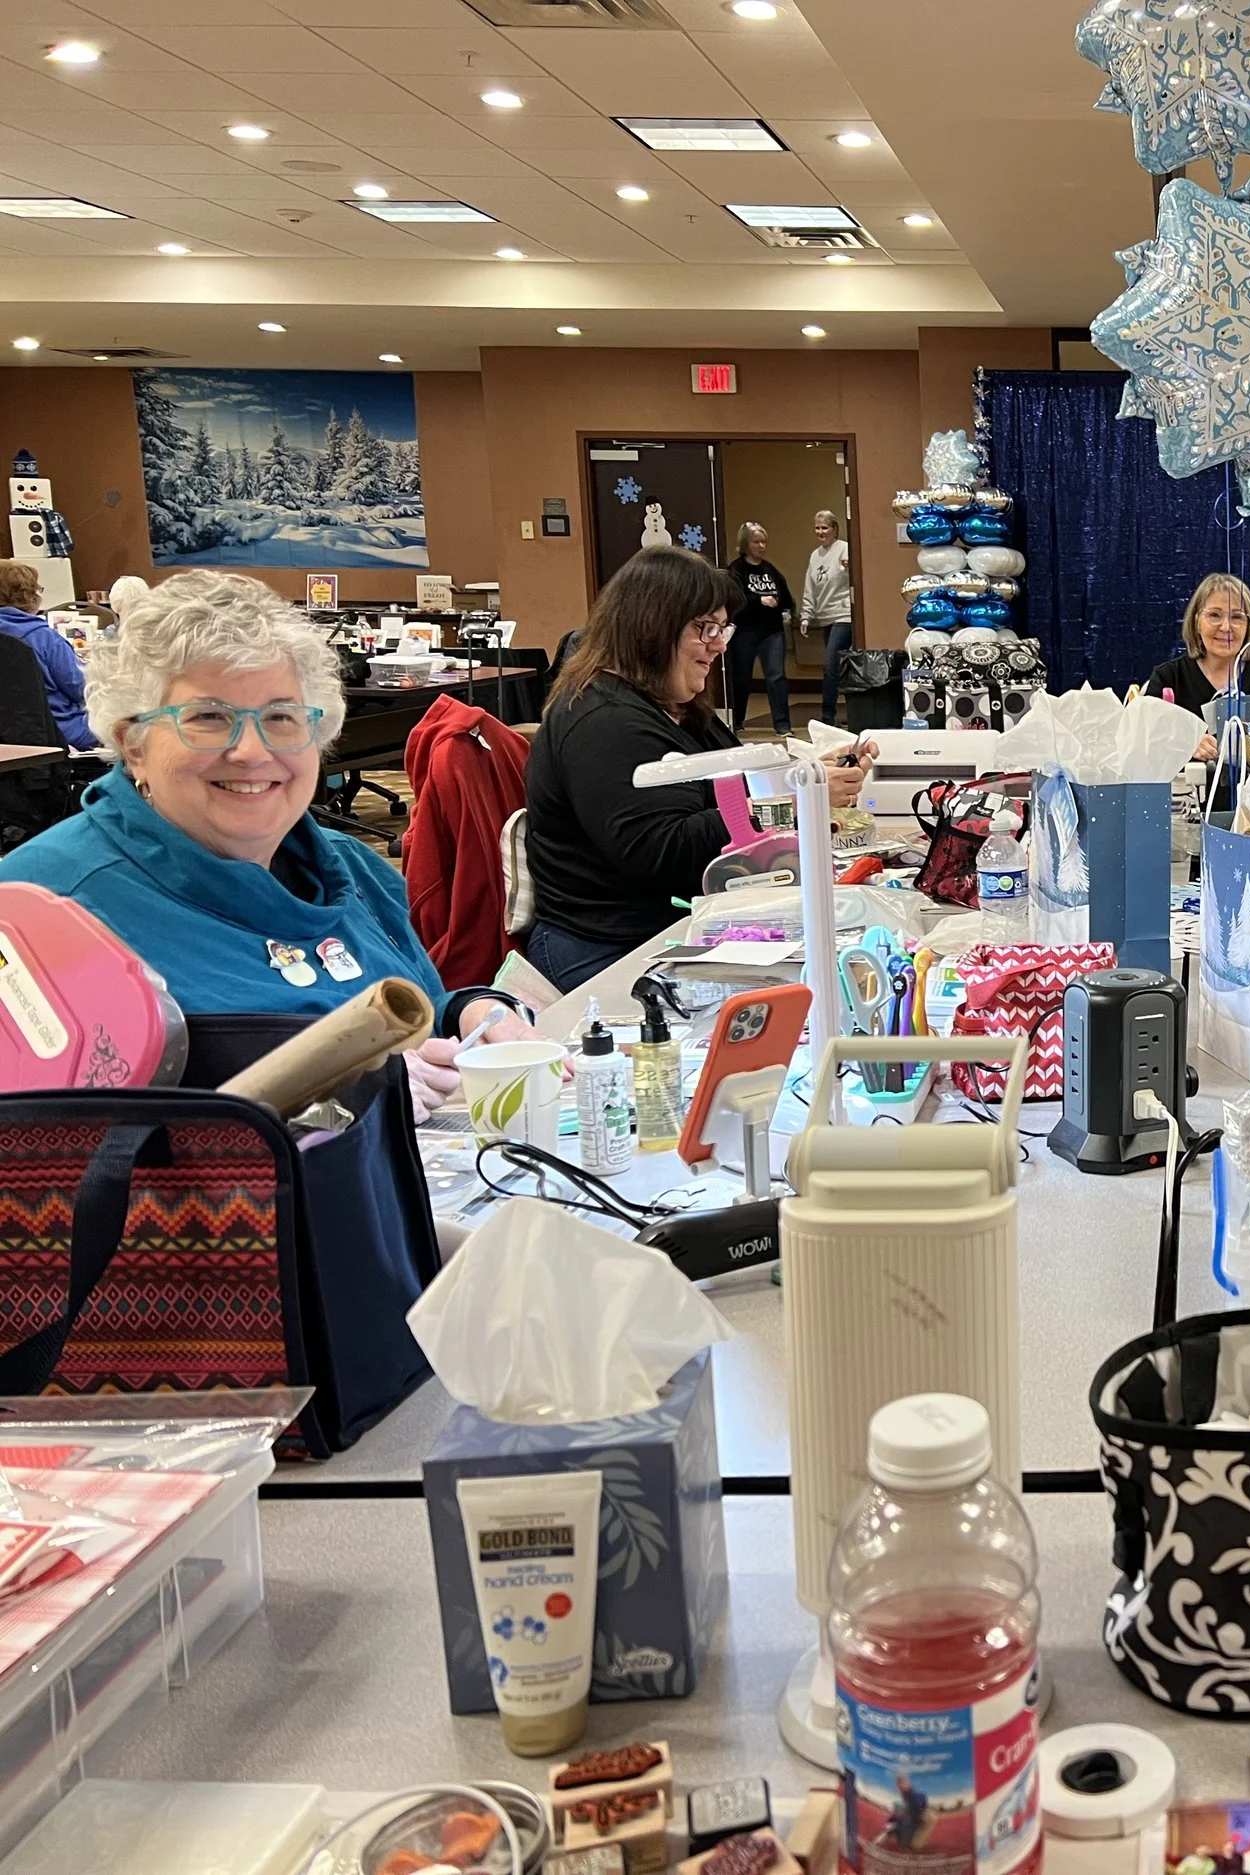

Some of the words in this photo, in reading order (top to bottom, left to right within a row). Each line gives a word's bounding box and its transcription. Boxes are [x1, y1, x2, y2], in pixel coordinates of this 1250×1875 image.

[699, 366, 730, 391] EXIT
[831, 832, 867, 848] INNY
[480, 1530, 523, 1549] GOLD
[527, 1526, 572, 1546] BOND
[485, 1575, 524, 1589] hand
[527, 1572, 574, 1587] cream
